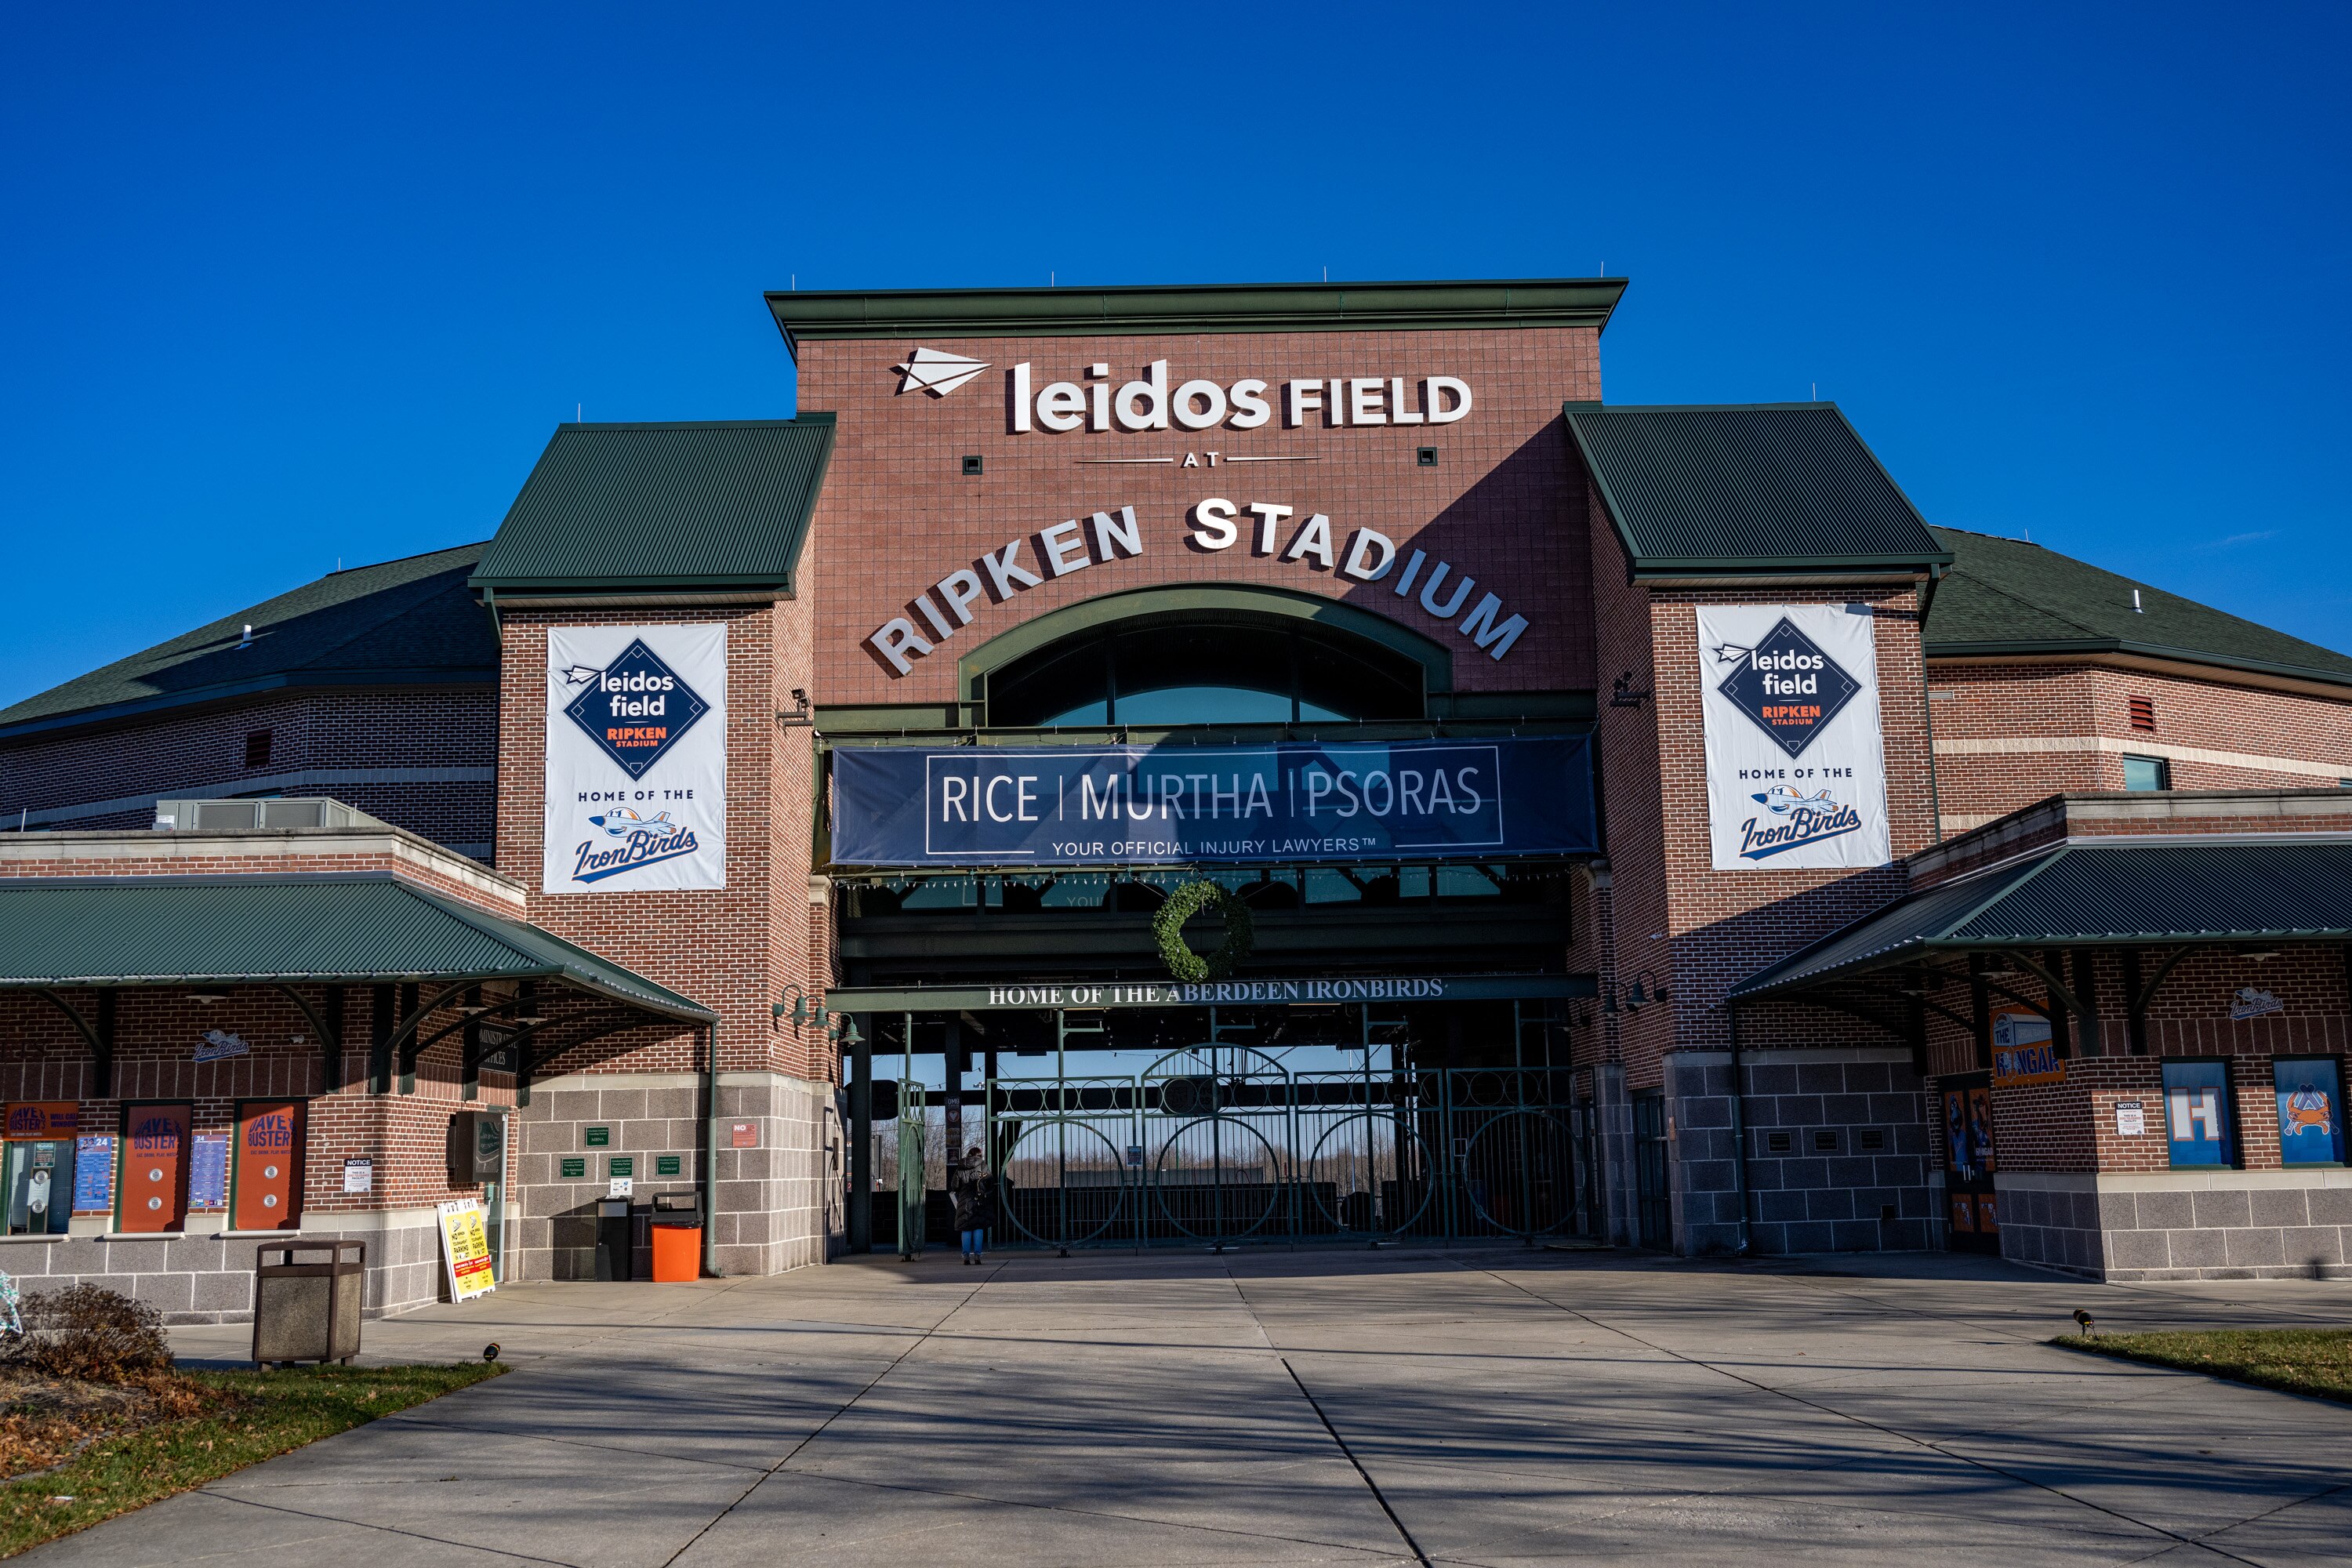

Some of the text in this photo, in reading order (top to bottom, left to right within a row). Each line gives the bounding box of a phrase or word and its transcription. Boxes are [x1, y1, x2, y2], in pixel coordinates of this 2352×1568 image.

[1014, 358, 1472, 433] leidos FIELD
[1184, 452, 1219, 467] AT
[869, 497, 1530, 676] RIPKEN STADIUM
[1751, 649, 1824, 670] leidos
[600, 670, 673, 692] leidos
[1762, 673, 1817, 695] field
[609, 695, 665, 717] field
[1762, 706, 1821, 718] RIPKEN
[607, 728, 666, 740] RIPKEN
[1739, 768, 1853, 779] HOME OF THE
[579, 789, 693, 802] HOME OF THE
[942, 765, 1482, 823] RICE MURTHA PSORAS
[1739, 804, 1862, 852] IronBirds
[573, 826, 699, 875] IronBirds
[1052, 840, 1105, 855] YOUR
[1110, 840, 1195, 855] OFFICIAL
[1199, 839, 1266, 855] INJURY
[988, 978, 1442, 1005] HOME OF THE ABERDEEN IRONBIRDS
[2230, 997, 2284, 1017] IronBirds
[1995, 1027, 2010, 1044] THE
[193, 1040, 249, 1059] IronBirds
[249, 1115, 287, 1133] DAVE
[2170, 1087, 2226, 1142] H
[136, 1117, 172, 1134] DAVE
[96, 1138, 108, 1147] 24
[454, 1244, 469, 1254] PARKING
[473, 1240, 485, 1249] PARKING
